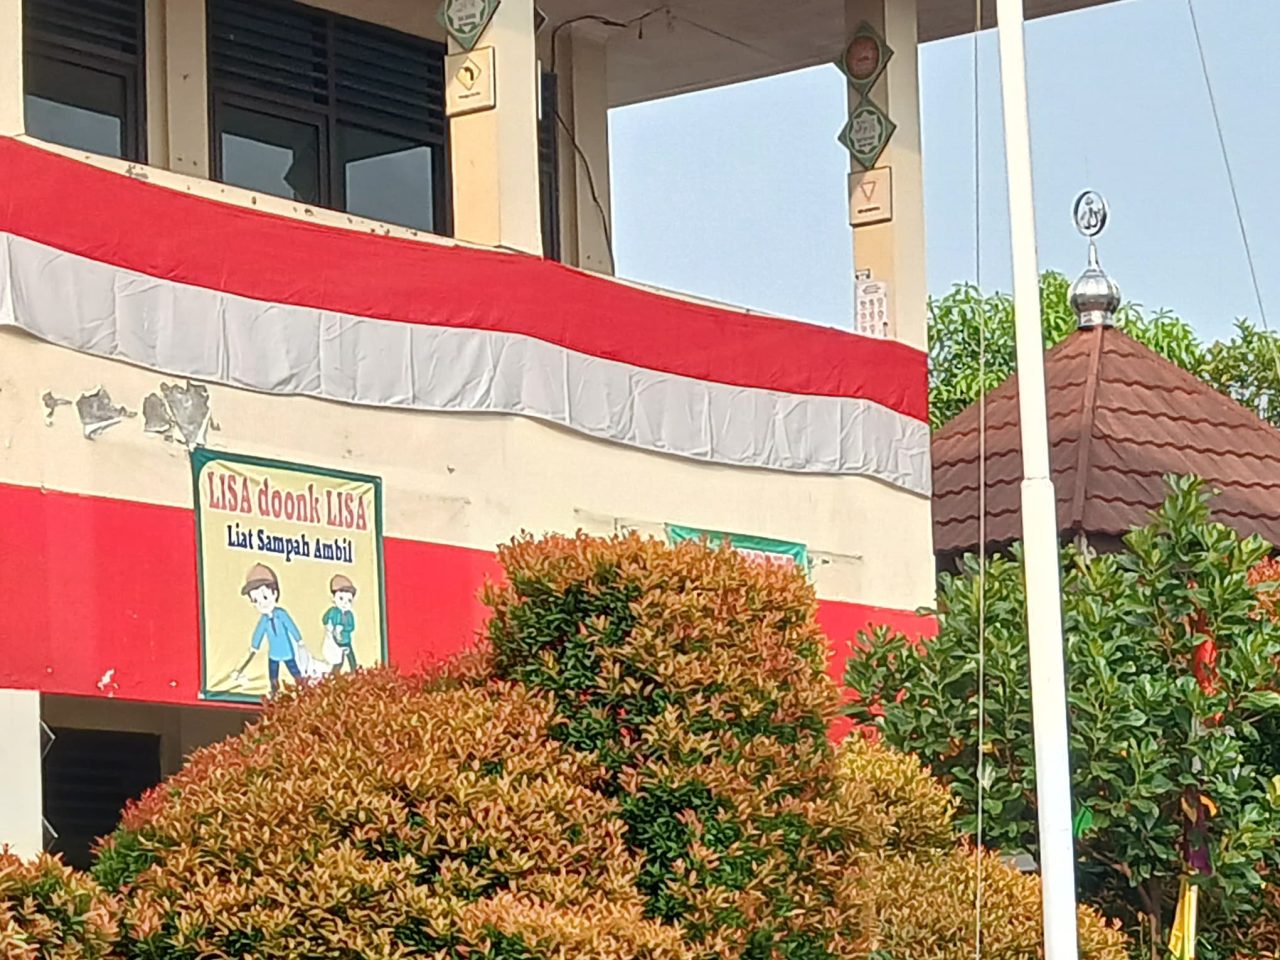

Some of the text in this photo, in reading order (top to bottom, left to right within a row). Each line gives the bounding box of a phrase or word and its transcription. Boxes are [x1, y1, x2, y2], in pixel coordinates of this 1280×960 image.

[207, 471, 368, 531] LISA doonk LISA
[227, 522, 353, 564] Liat Sampah Ambil
